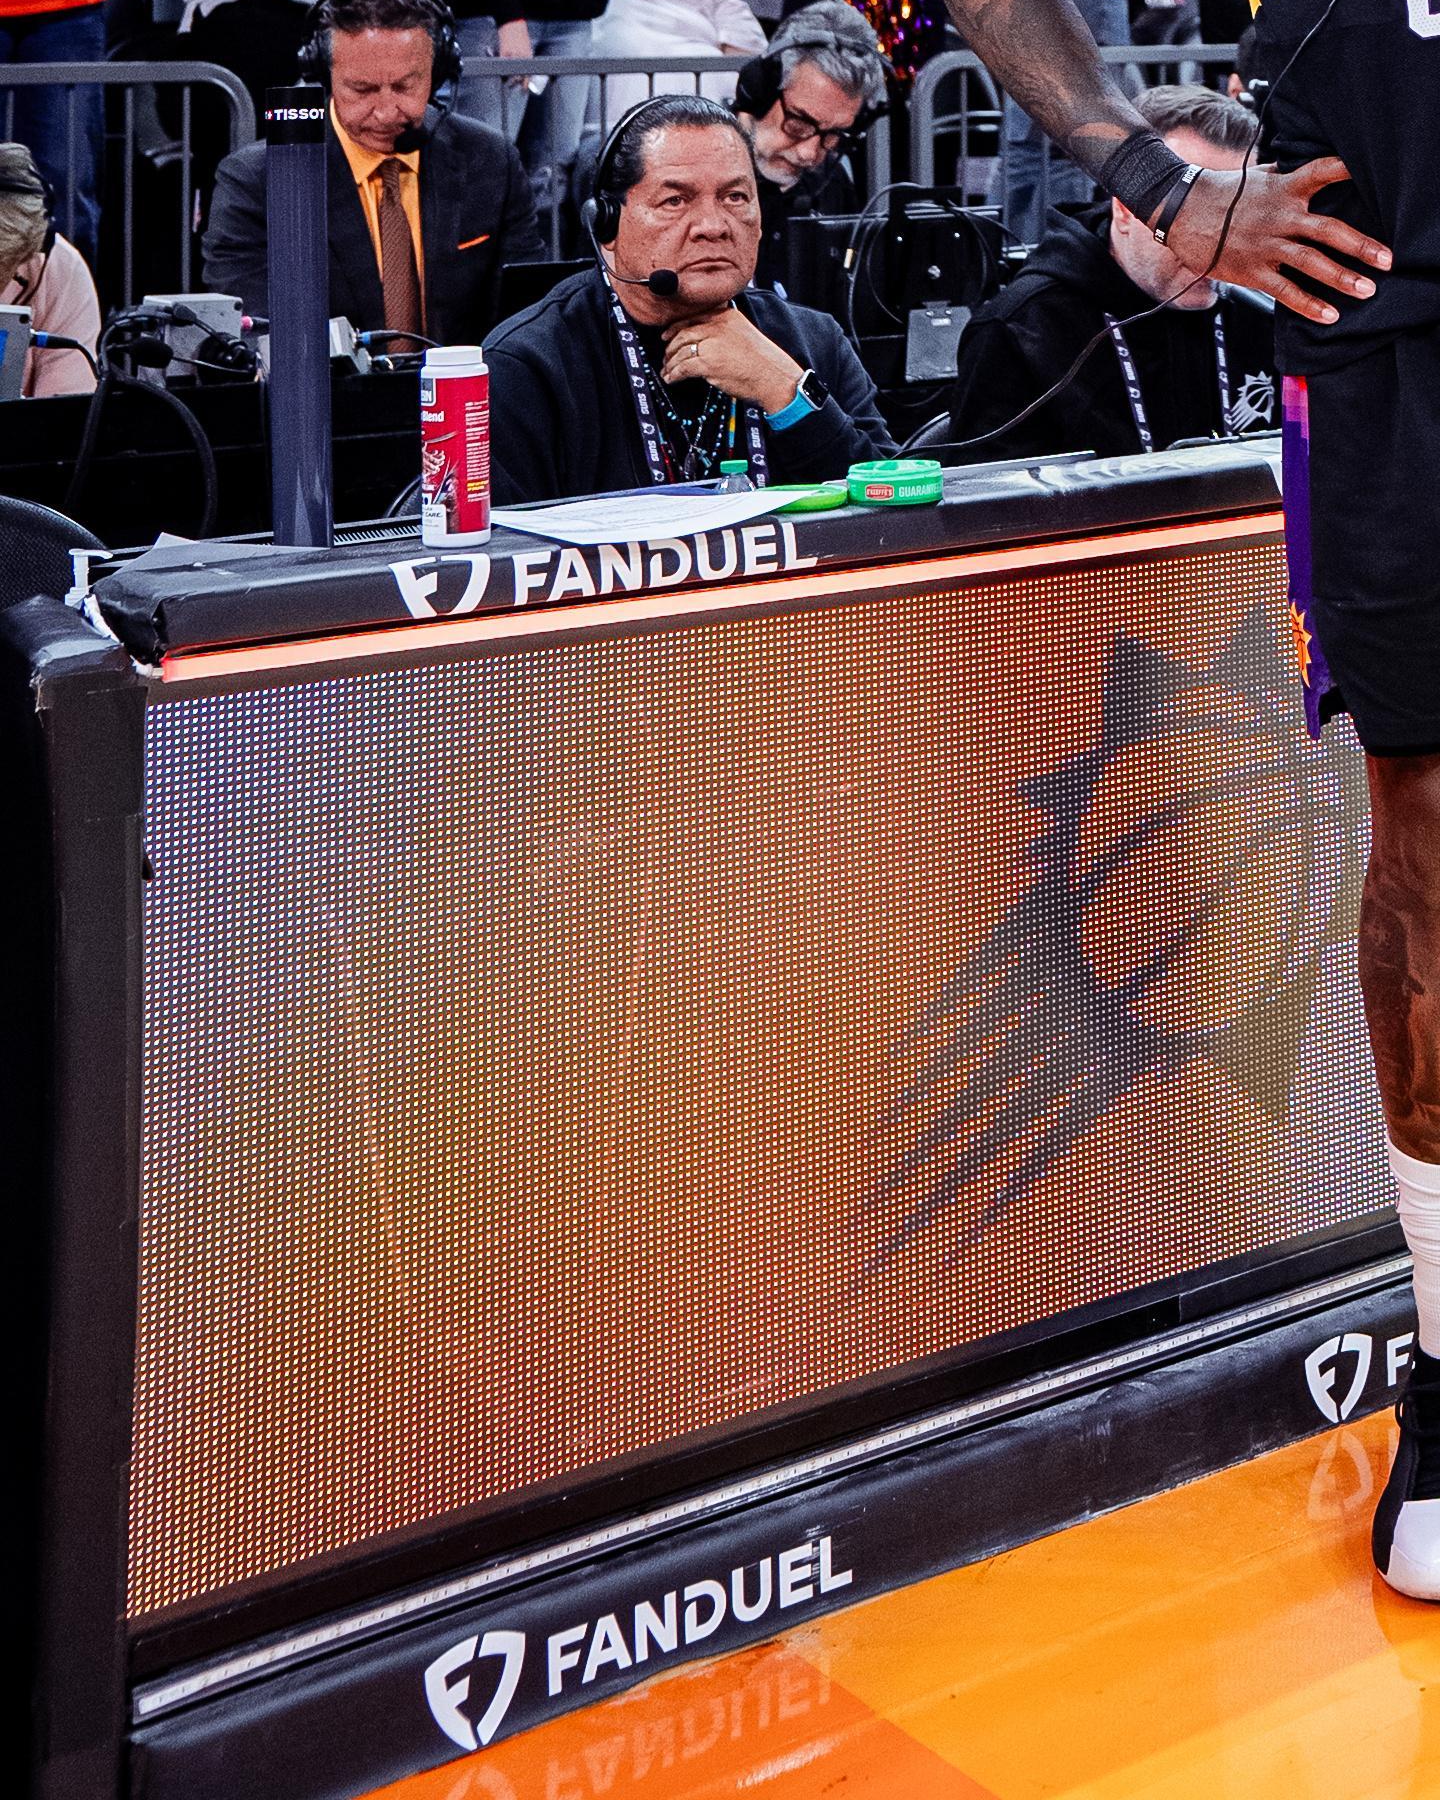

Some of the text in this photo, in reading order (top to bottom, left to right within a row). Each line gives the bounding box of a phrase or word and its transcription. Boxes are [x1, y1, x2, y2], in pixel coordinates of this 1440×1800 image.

[274, 108, 325, 121] TISSOT
[512, 521, 819, 607] FANDUEL
[547, 1535, 853, 1697] FANDUEL
